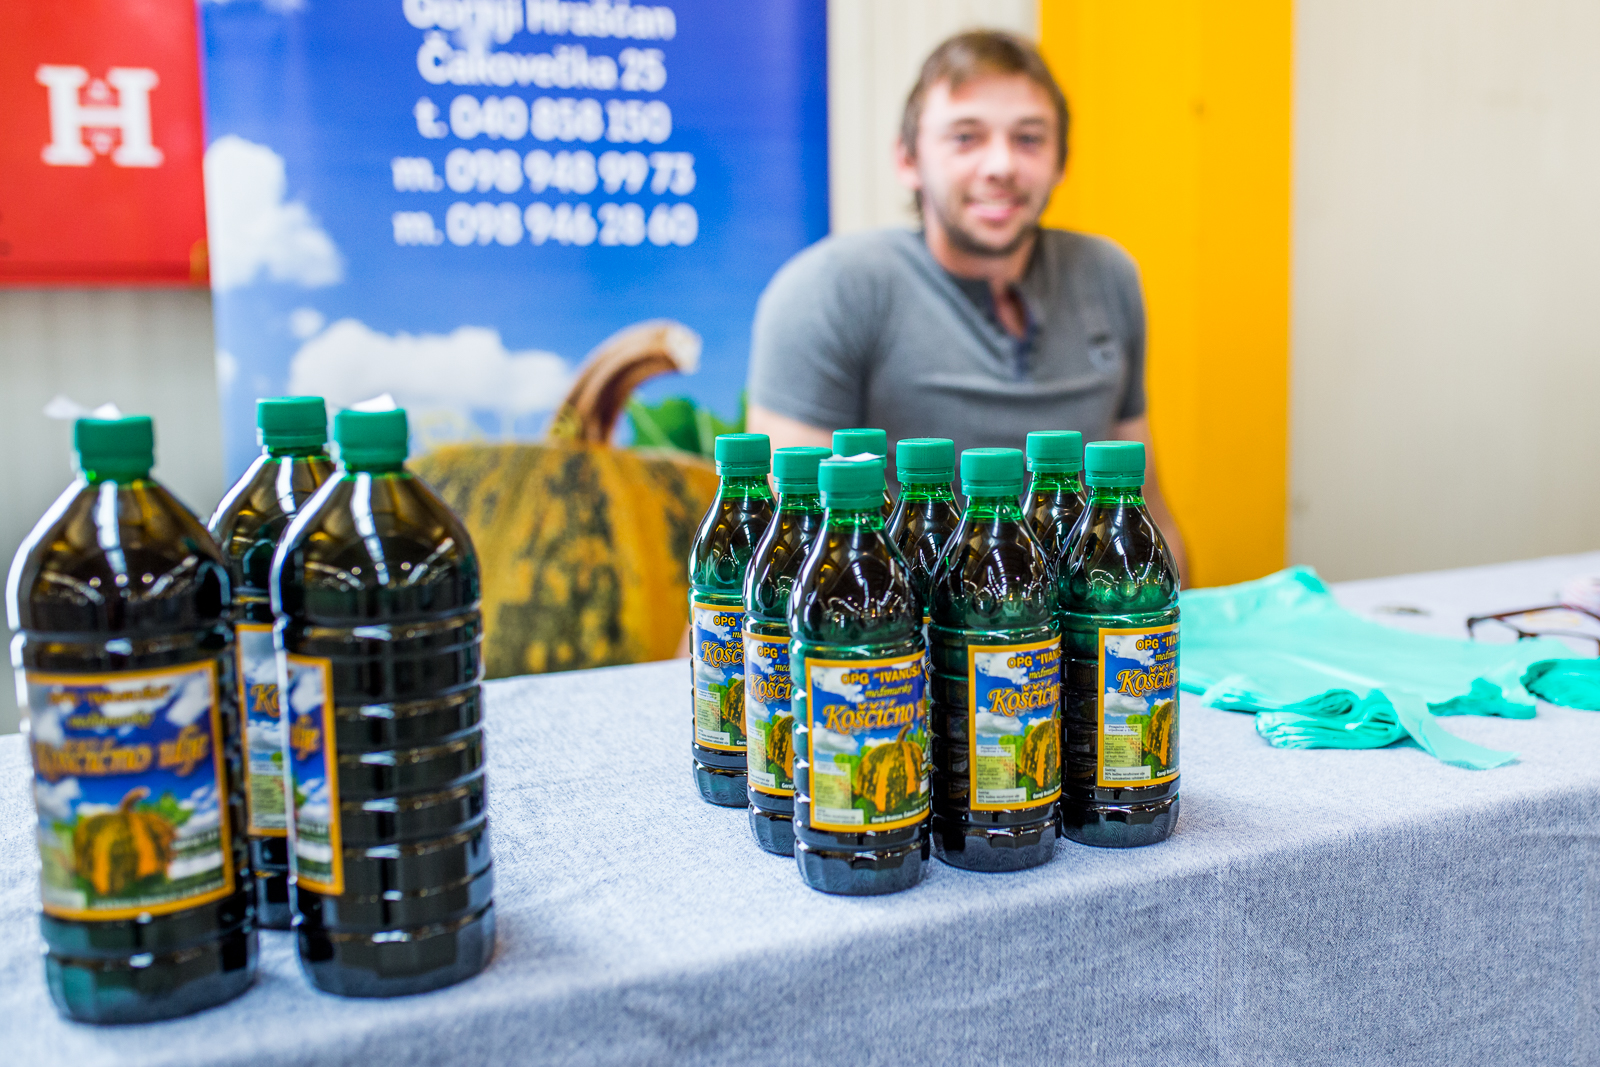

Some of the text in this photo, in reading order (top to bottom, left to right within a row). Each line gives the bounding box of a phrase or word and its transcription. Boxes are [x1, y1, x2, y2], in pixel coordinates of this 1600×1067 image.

[619, 48, 667, 92] 25
[413, 97, 449, 139] t.
[450, 95, 529, 140] 040
[605, 99, 672, 144] 150
[391, 149, 696, 196] m. 098 948 99 73
[391, 202, 698, 246] m. 098 946 28 60
[713, 615, 736, 627] OPG
[701, 641, 744, 668] Košč
[757, 646, 778, 659] OPG
[1136, 638, 1159, 650] OPG
[1007, 655, 1033, 668] OPG
[840, 672, 870, 685] OPG
[823, 699, 915, 735] Koščićno
